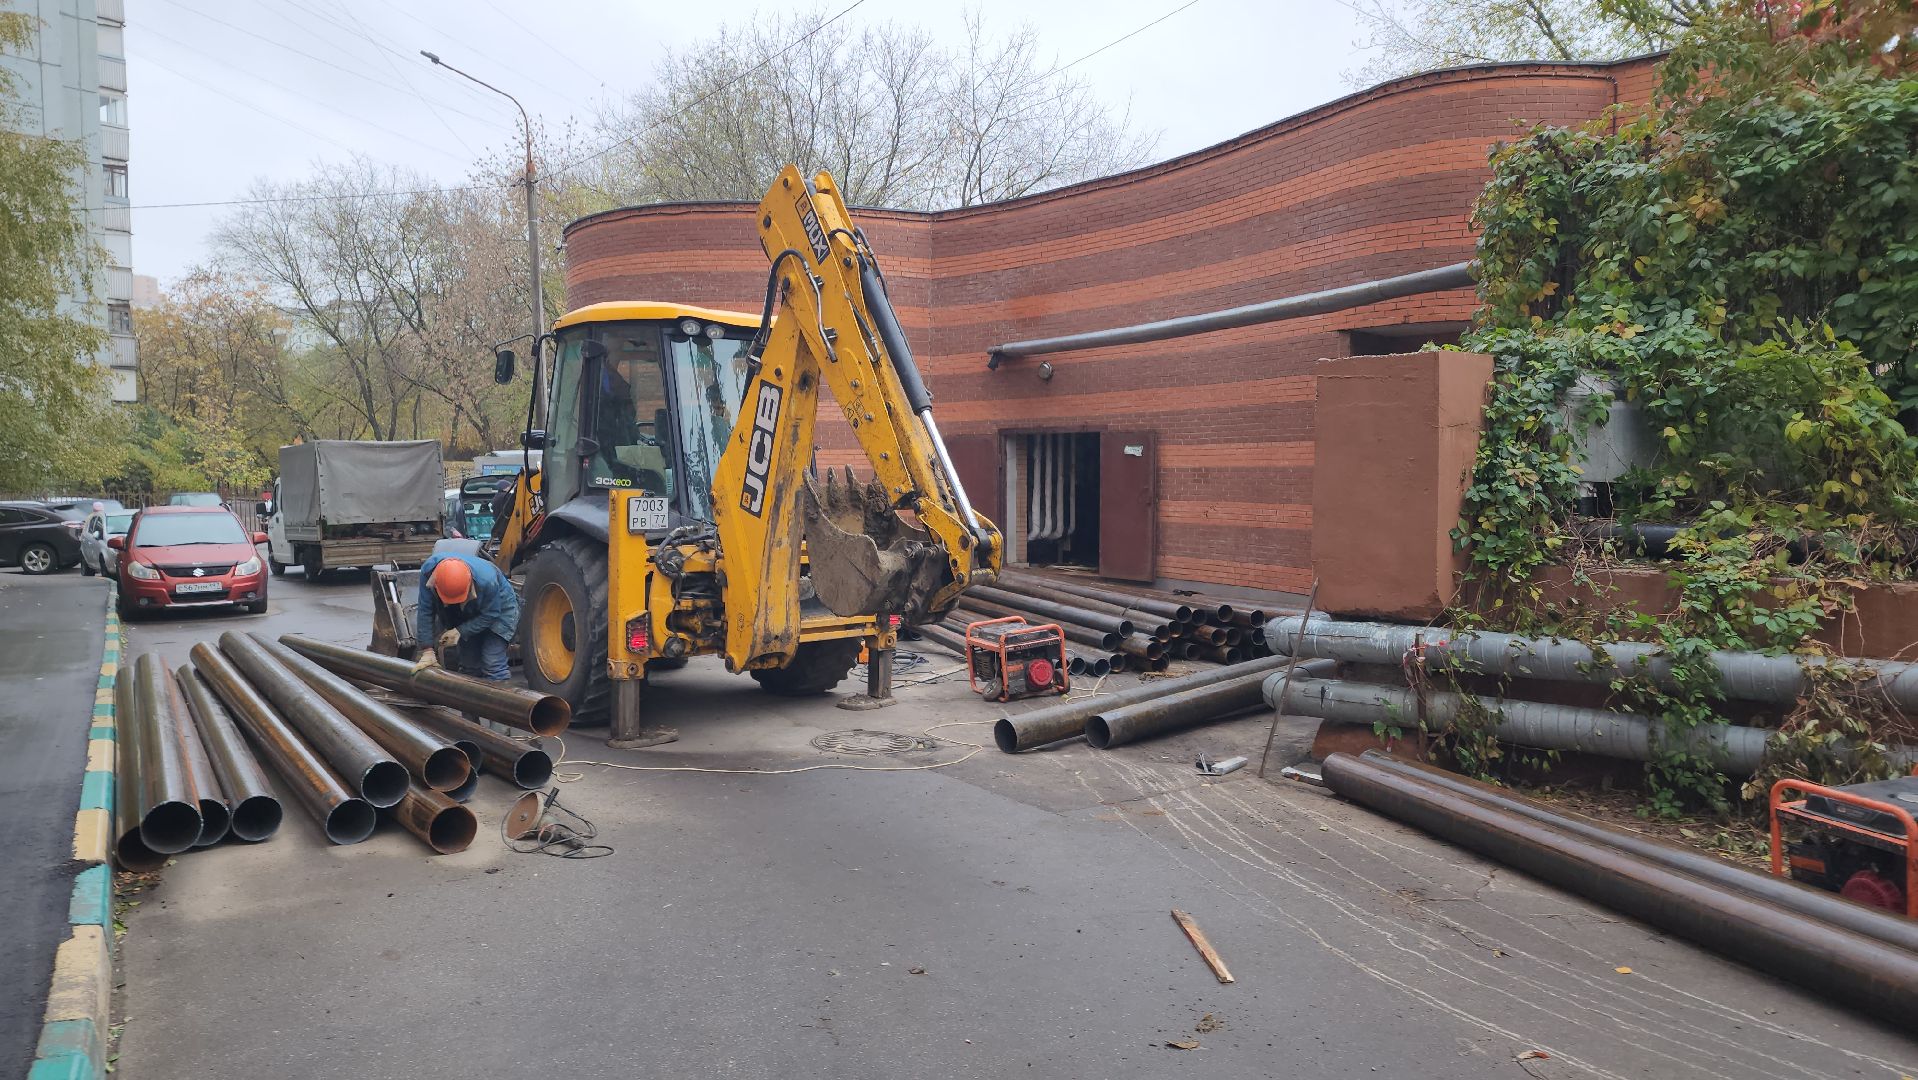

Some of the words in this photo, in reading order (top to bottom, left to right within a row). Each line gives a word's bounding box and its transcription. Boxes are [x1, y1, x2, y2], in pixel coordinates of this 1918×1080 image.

[745, 385, 780, 513] JCB
[634, 499, 664, 512] 7003
[653, 514, 666, 524] 77
